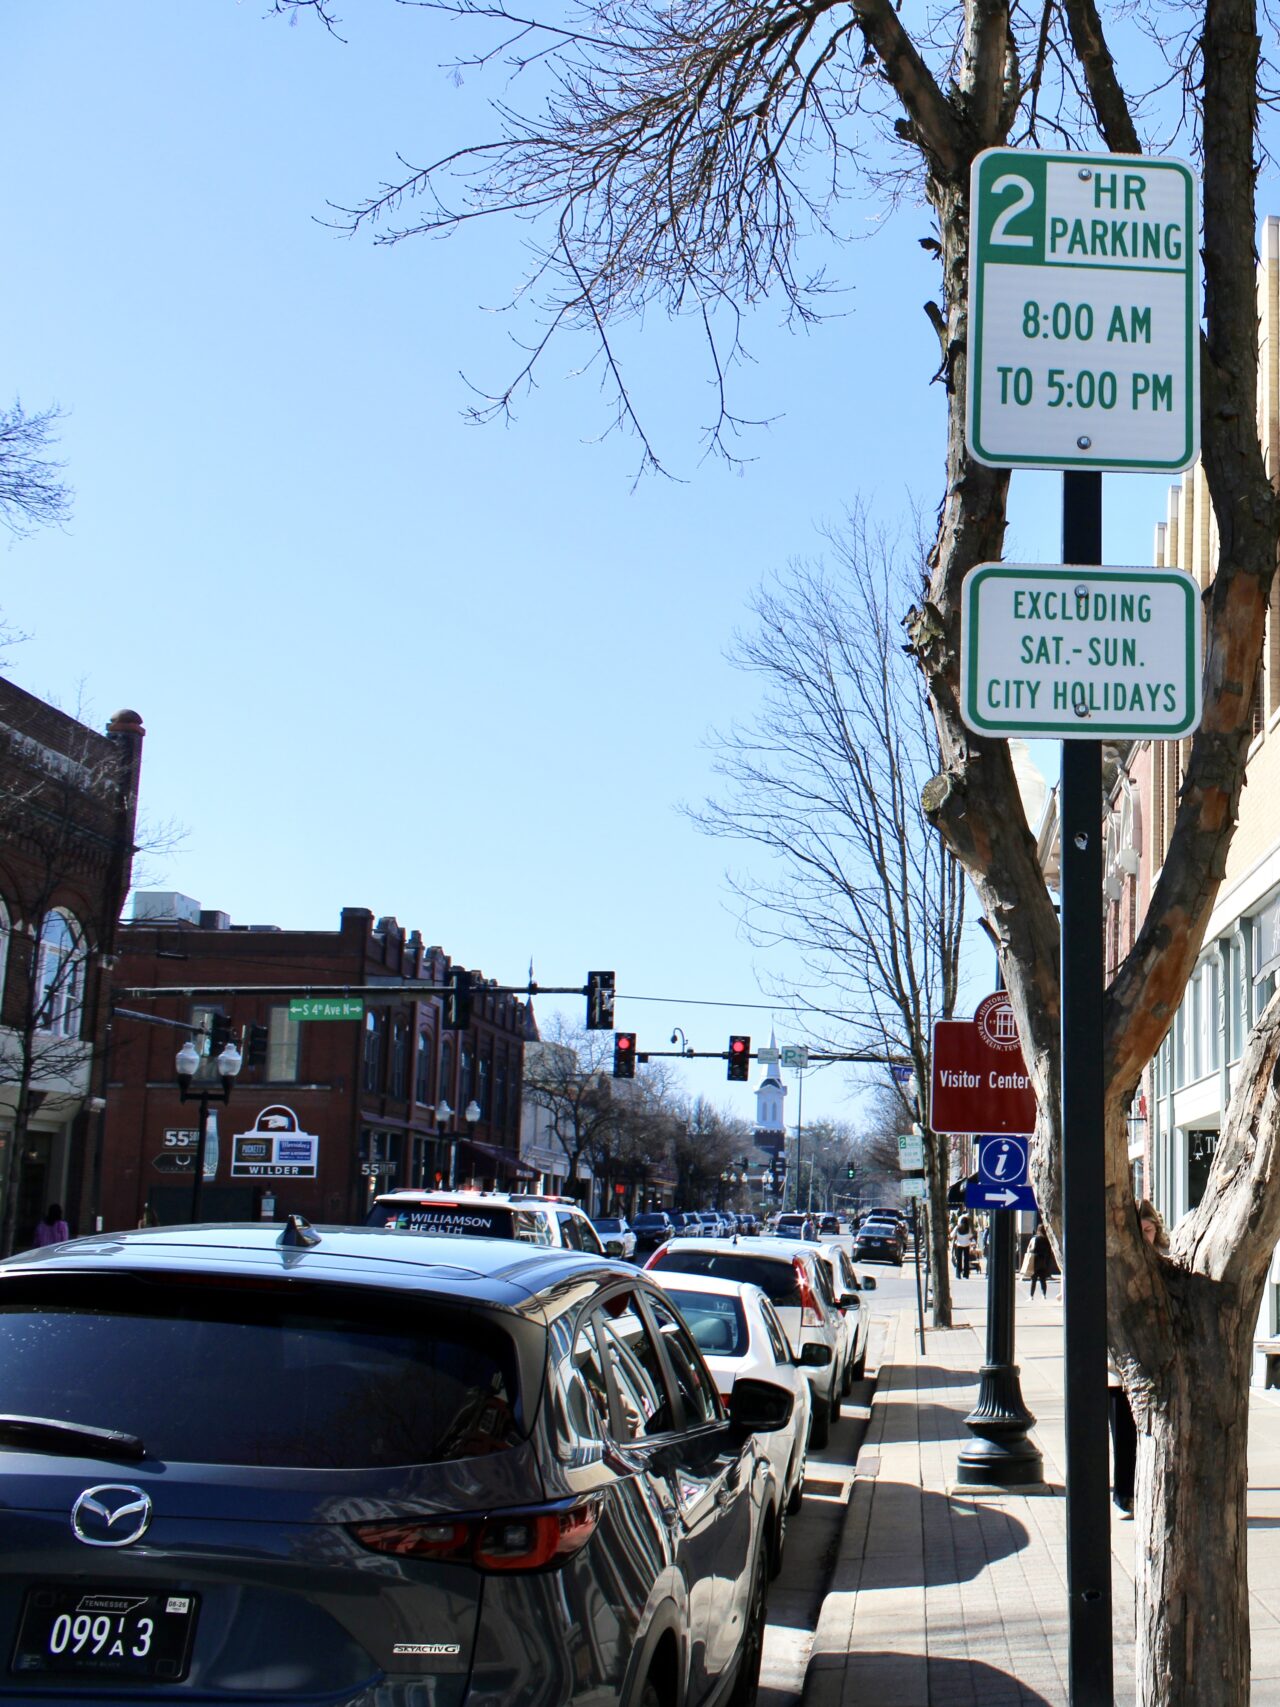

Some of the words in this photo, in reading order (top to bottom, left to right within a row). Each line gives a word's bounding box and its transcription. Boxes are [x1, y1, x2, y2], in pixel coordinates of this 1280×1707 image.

[989, 173, 1035, 247] 2
[1094, 173, 1146, 210] HR
[1050, 217, 1182, 260] PARKING
[1022, 300, 1094, 341] 8:00
[1107, 305, 1151, 344] AM
[997, 366, 1033, 406] TO
[1047, 369, 1117, 410] 5:00
[1132, 373, 1172, 412] PM
[1013, 590, 1151, 623] EXCLUDING
[987, 679, 1041, 709] CITY
[1053, 681, 1176, 713] HOLIDAYS
[303, 1003, 309, 1016] S
[324, 1003, 341, 1016] Ave
[343, 1003, 350, 1016] N
[939, 1069, 981, 1088] Visitor
[988, 1071, 1030, 1089] Center
[164, 1130, 189, 1146] 55
[249, 1166, 299, 1175] WILDER
[361, 1163, 380, 1175] 55
[409, 1223, 464, 1235] HEALTH
[410, 1213, 492, 1228] WILLIAMSON
[85, 1600, 129, 1609] TENNESSEE
